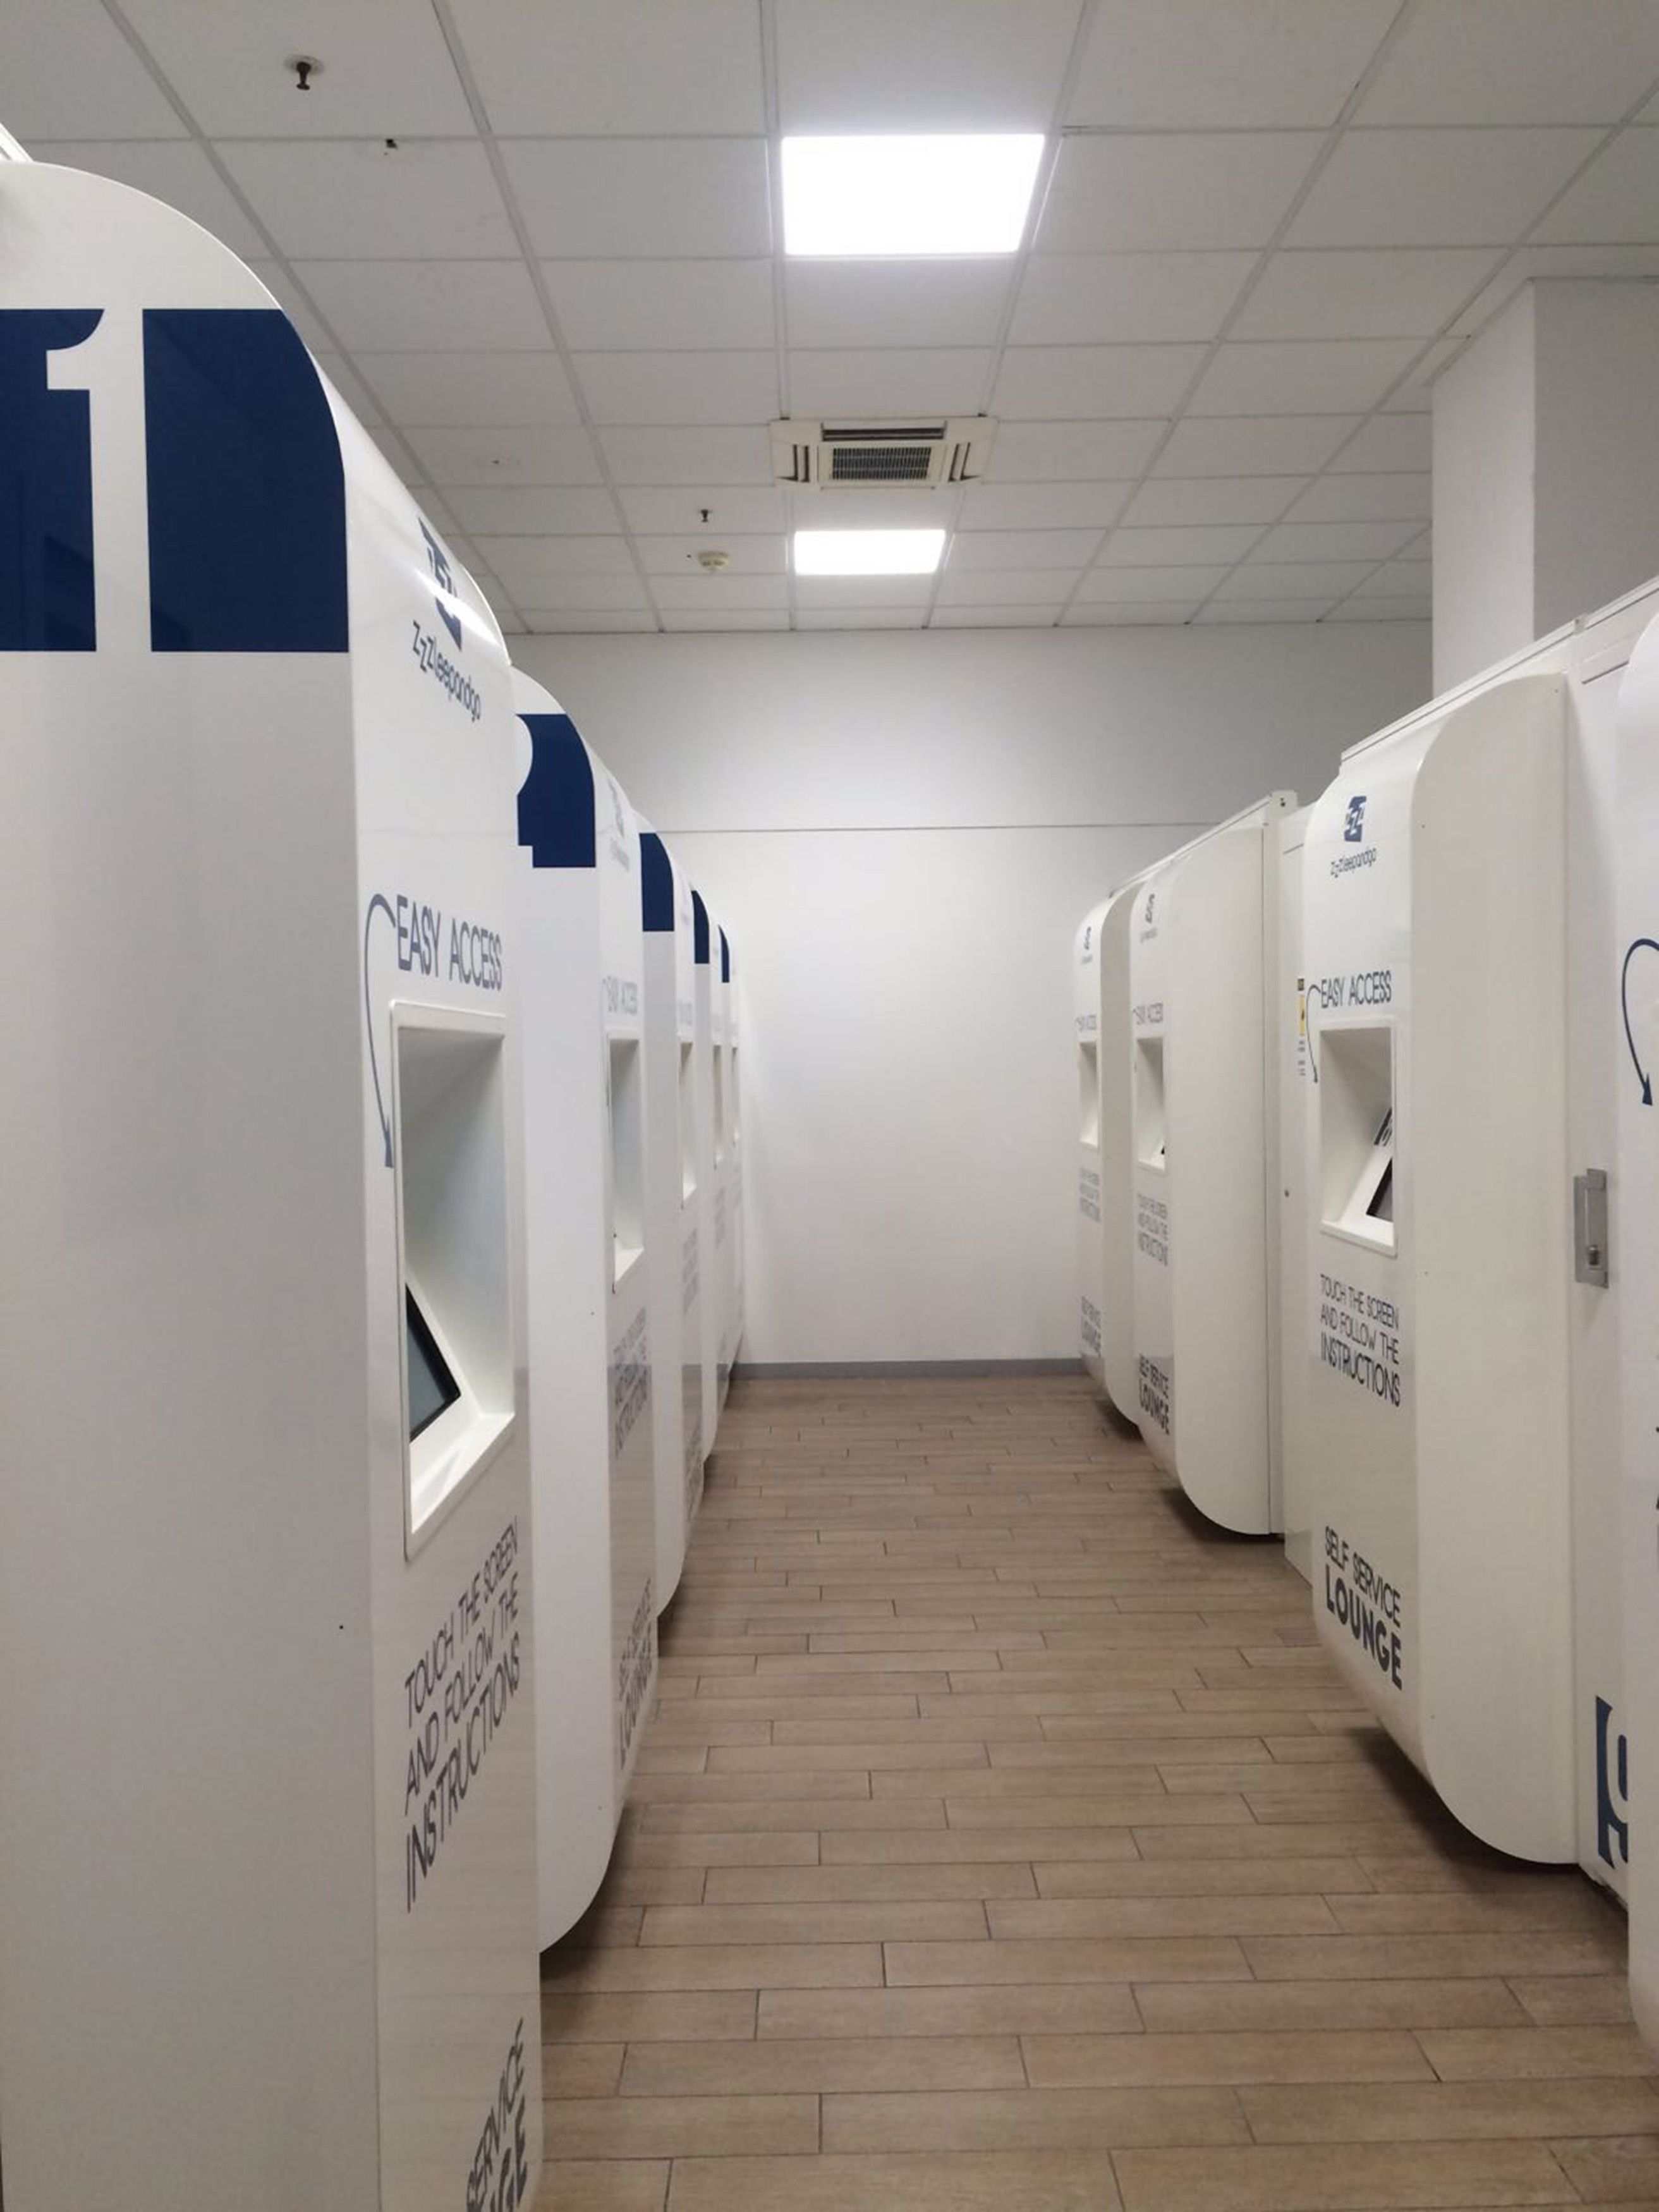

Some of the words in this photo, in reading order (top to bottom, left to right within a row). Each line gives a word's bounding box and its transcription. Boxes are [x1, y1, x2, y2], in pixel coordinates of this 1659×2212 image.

[46, 309, 152, 652] 1
[396, 894, 441, 978] EASY
[449, 918, 502, 992] ACCESS
[1322, 977, 1345, 1009] EASY
[1348, 970, 1392, 1006] ACCESS
[1320, 1273, 1347, 1306] TOUCH
[1348, 1286, 1364, 1315] THE
[1367, 1296, 1399, 1331] SCREEN
[1321, 1303, 1338, 1330] AND
[1340, 1311, 1376, 1351] FOLLOW
[1380, 1331, 1399, 1365] THE
[1321, 1331, 1401, 1407] INSTRUCTIONS
[405, 1612, 454, 1729] TOUCH
[458, 1571, 480, 1643] THE
[483, 1516, 518, 1603] SCREEN
[1325, 1526, 1349, 1571] SELF
[1353, 1552, 1401, 1629] SERVICE
[1325, 1564, 1402, 1691] LOUNGE
[405, 1711, 439, 1815] AND
[444, 1609, 495, 1742] FOLLOW
[498, 1571, 518, 1639] THE
[406, 1631, 520, 1913] INSTRUCTIONS
